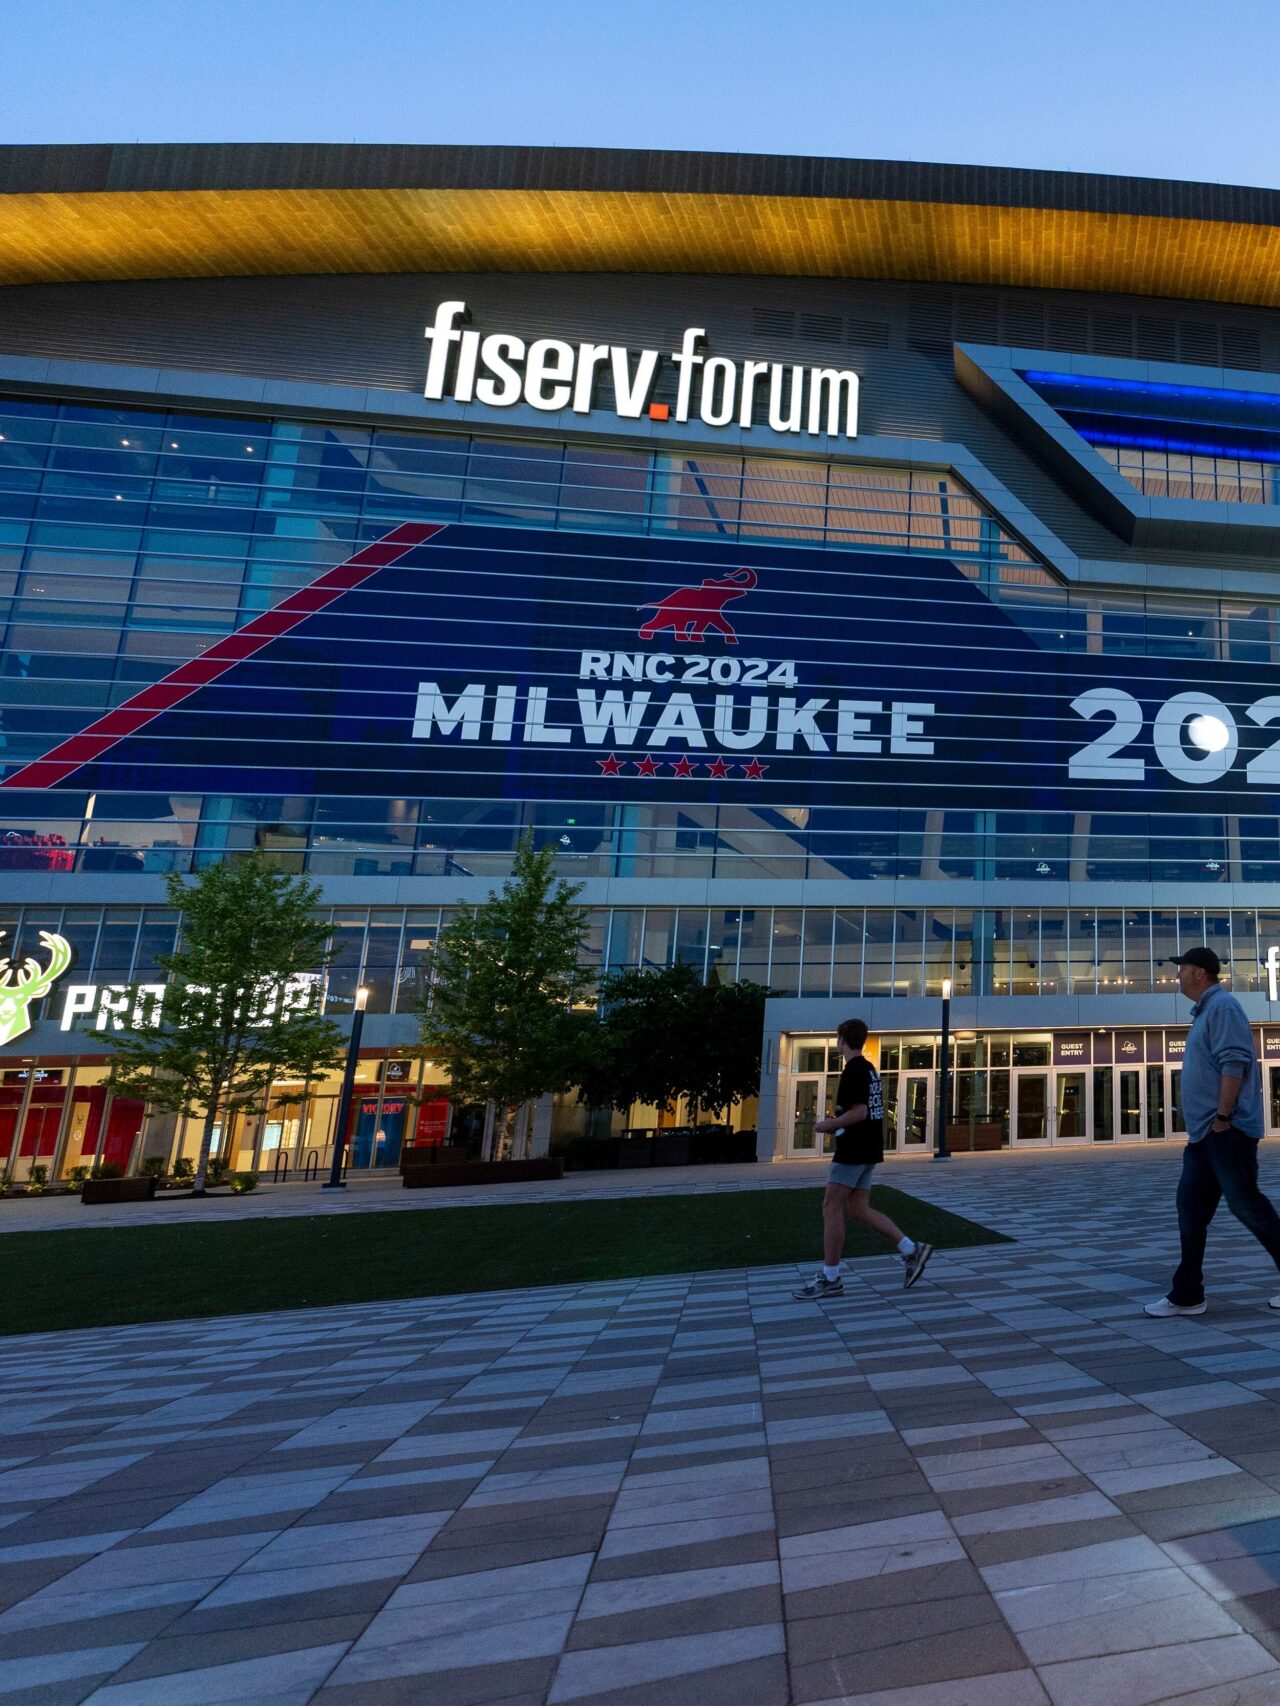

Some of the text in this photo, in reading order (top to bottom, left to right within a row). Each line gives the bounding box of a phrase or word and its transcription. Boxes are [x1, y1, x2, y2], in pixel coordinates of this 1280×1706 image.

[580, 649, 798, 688] RNC 2024
[412, 682, 936, 755] MILWAUKEE
[60, 984, 167, 1031] PRO
[363, 1103, 404, 1113] VICORY
